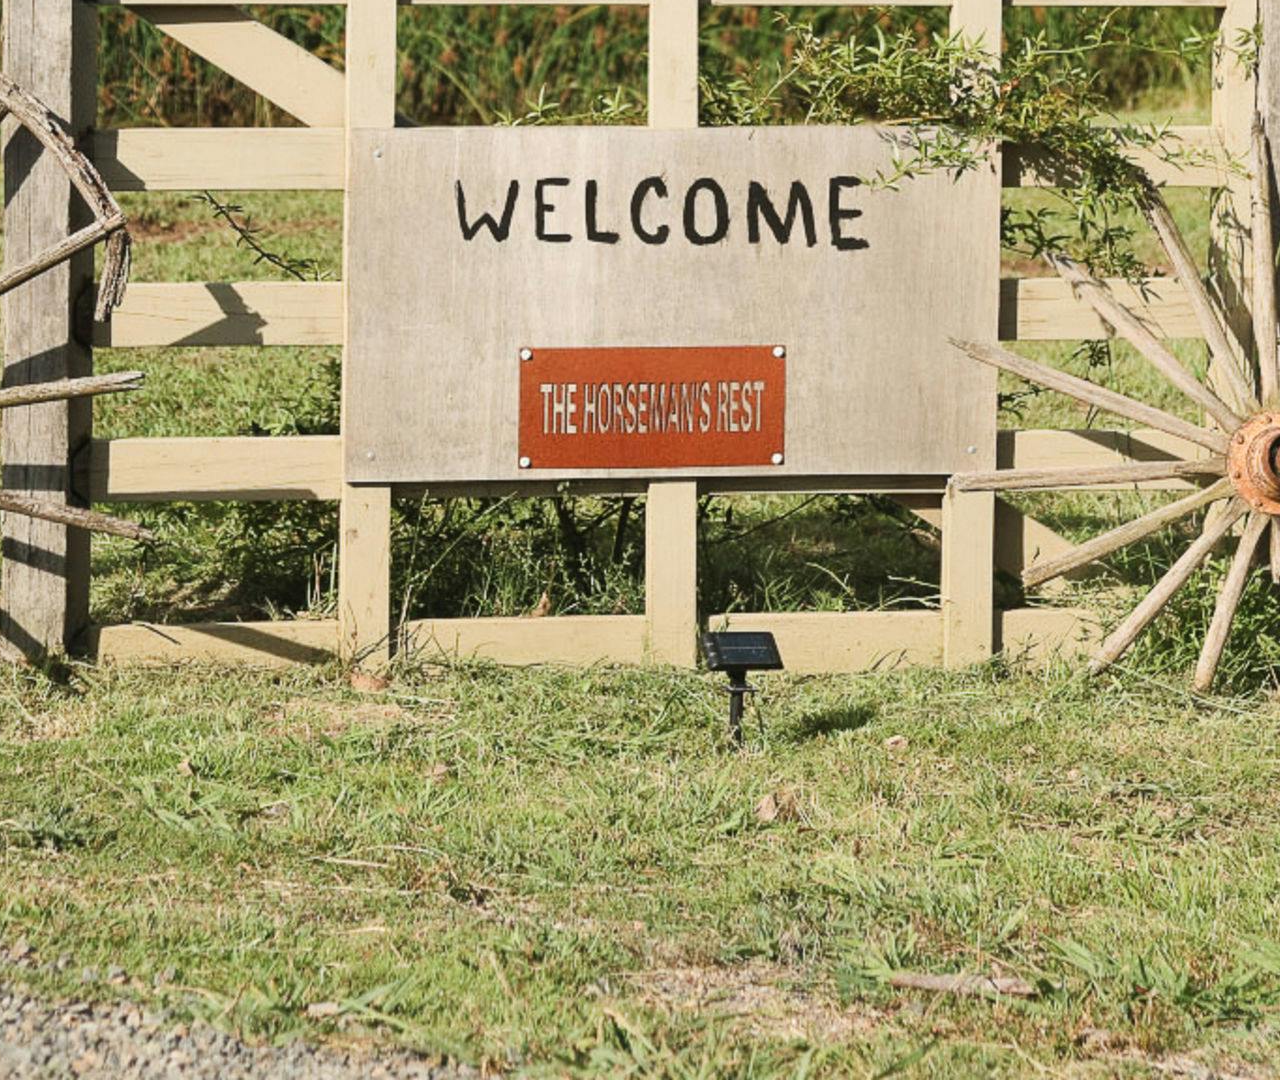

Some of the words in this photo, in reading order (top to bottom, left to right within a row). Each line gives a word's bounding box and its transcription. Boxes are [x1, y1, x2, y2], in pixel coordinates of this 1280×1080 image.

[456, 176, 870, 250] WELCOME
[540, 383, 577, 434] THE
[583, 382, 711, 434] HORSEMAN'S
[717, 381, 765, 432] REST
